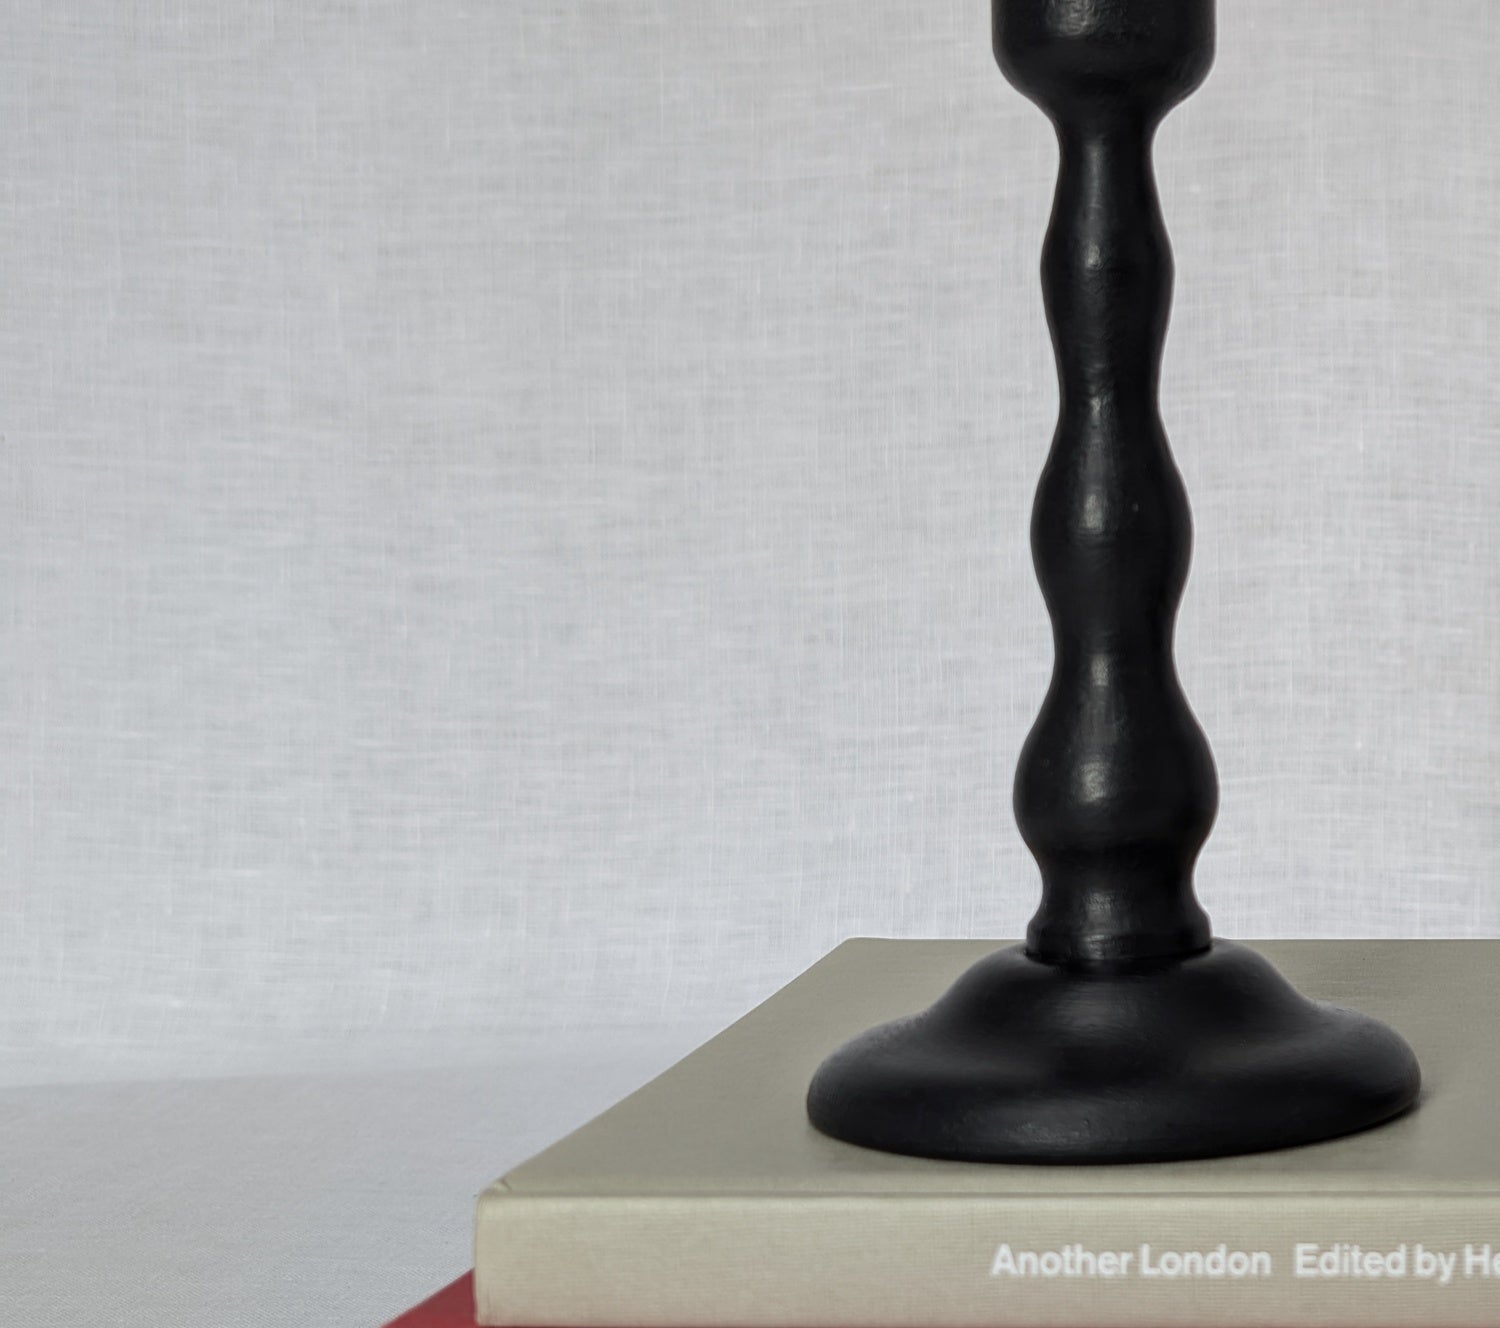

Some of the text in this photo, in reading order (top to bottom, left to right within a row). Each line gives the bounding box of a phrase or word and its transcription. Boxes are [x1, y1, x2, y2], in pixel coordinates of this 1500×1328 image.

[990, 1244, 1134, 1279] Another
[1139, 1244, 1273, 1280] London
[1294, 1243, 1408, 1279] Edited
[1414, 1244, 1458, 1285] by
